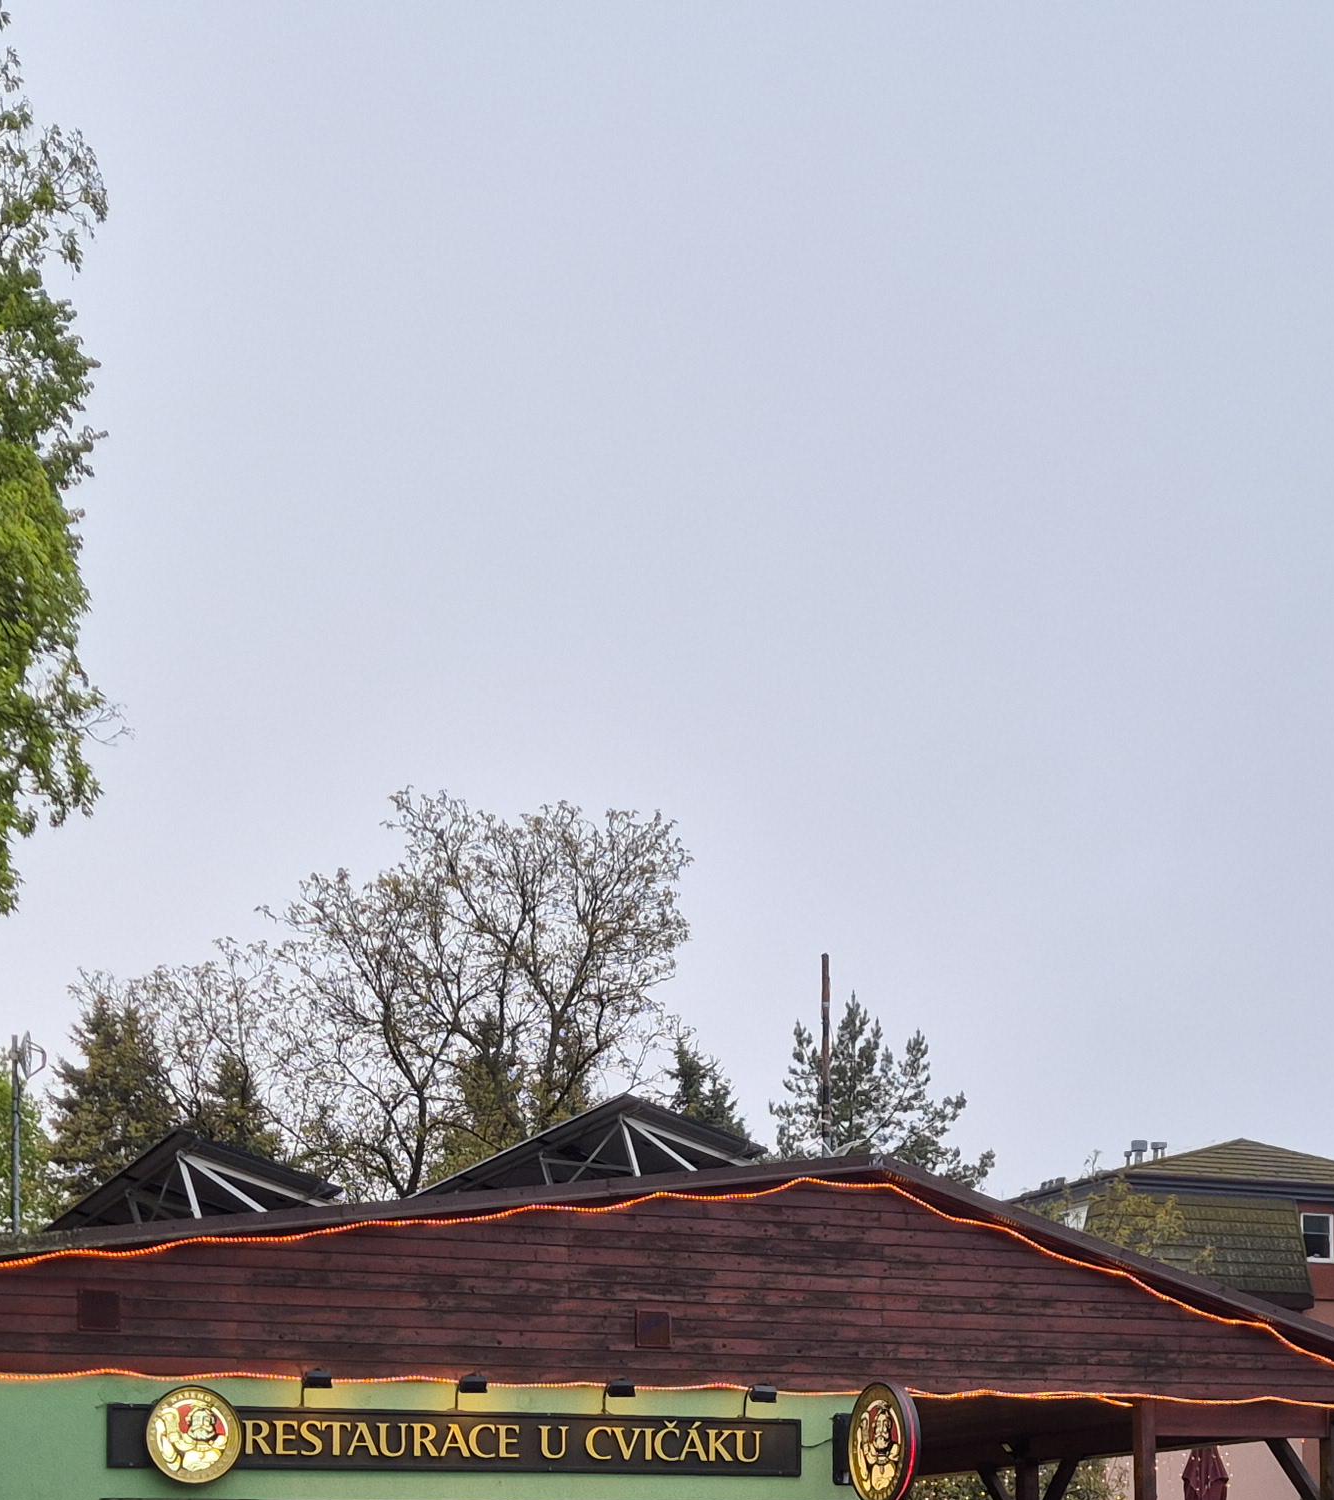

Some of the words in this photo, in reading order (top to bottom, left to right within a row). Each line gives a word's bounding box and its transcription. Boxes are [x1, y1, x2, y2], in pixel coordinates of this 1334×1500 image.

[242, 1419, 520, 1459] RESTAURACE
[538, 1424, 569, 1460] U
[585, 1420, 763, 1463] CVIČÁKU
